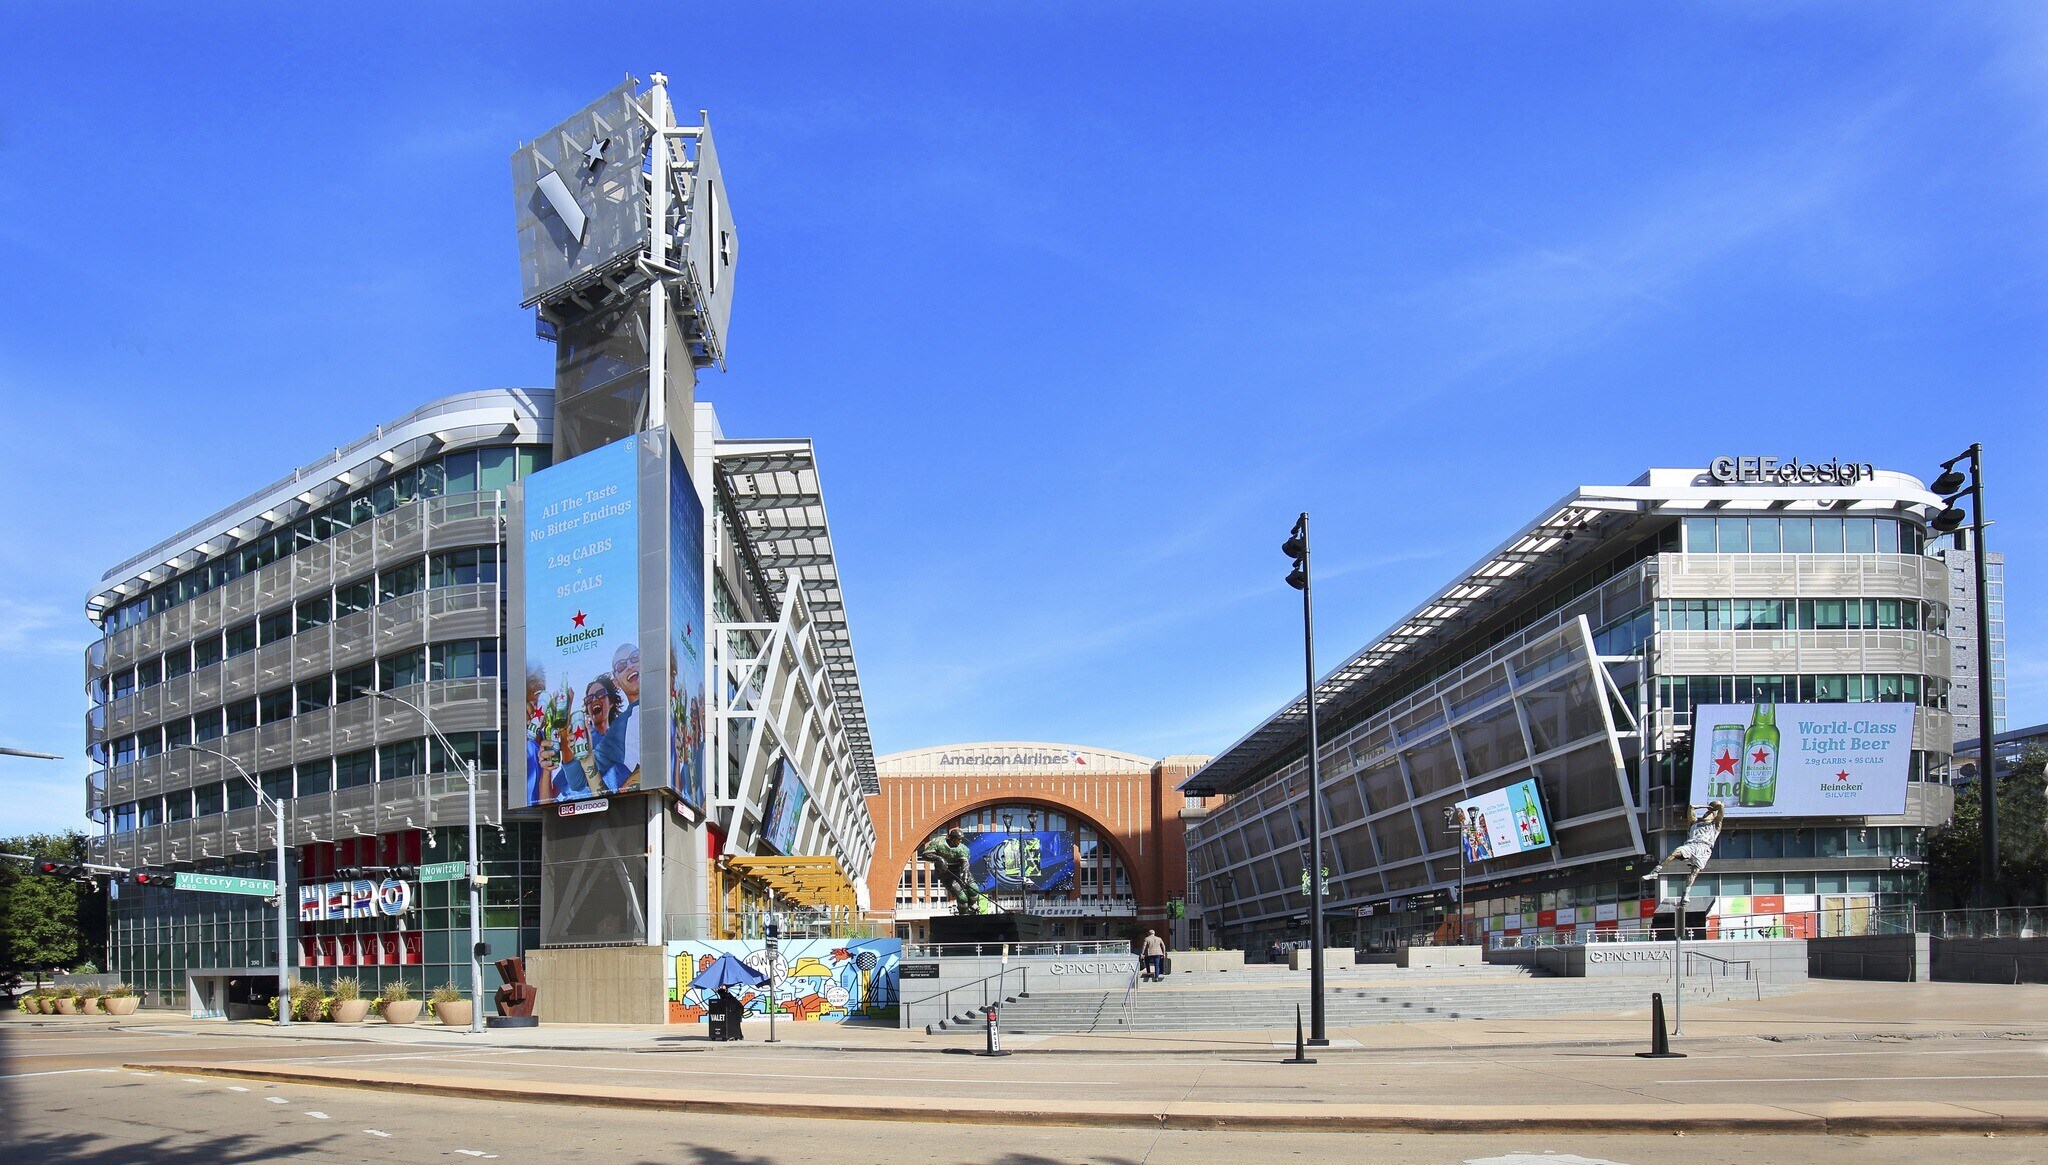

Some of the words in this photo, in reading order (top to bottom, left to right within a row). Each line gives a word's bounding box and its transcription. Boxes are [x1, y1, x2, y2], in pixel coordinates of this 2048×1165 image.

[542, 503, 559, 519] All
[561, 497, 583, 512] The
[585, 485, 618, 503] Taste
[530, 529, 545, 542] No
[547, 517, 580, 537] Bitter
[582, 500, 632, 525] Endings
[548, 554, 571, 569] 2.9g
[573, 538, 612, 560] CARBS
[558, 584, 571, 598] 95
[573, 574, 603, 593] CALS
[556, 626, 605, 647] Heineken
[562, 640, 598, 656] SILVER
[1798, 721, 1897, 735] World-Class
[1801, 738, 1846, 754] Light
[1850, 737, 1890, 751] Beer
[940, 753, 1011, 765] American
[1012, 753, 1069, 765] Airlines
[1805, 758, 1820, 766] 2.9g
[1820, 783, 1863, 791] Heineken
[561, 804, 574, 815] BIG
[575, 801, 608, 812] OUTDOOR
[425, 863, 460, 875] Nowitzki
[180, 873, 233, 888] Victory
[240, 880, 270, 890] Park
[299, 878, 411, 922] HERO
[1604, 951, 1632, 962] PNC
[1634, 950, 1670, 961] PLAZA
[1066, 963, 1094, 974] PNC
[1097, 962, 1136, 974] PLAZA
[710, 1013, 726, 1022] VALET
